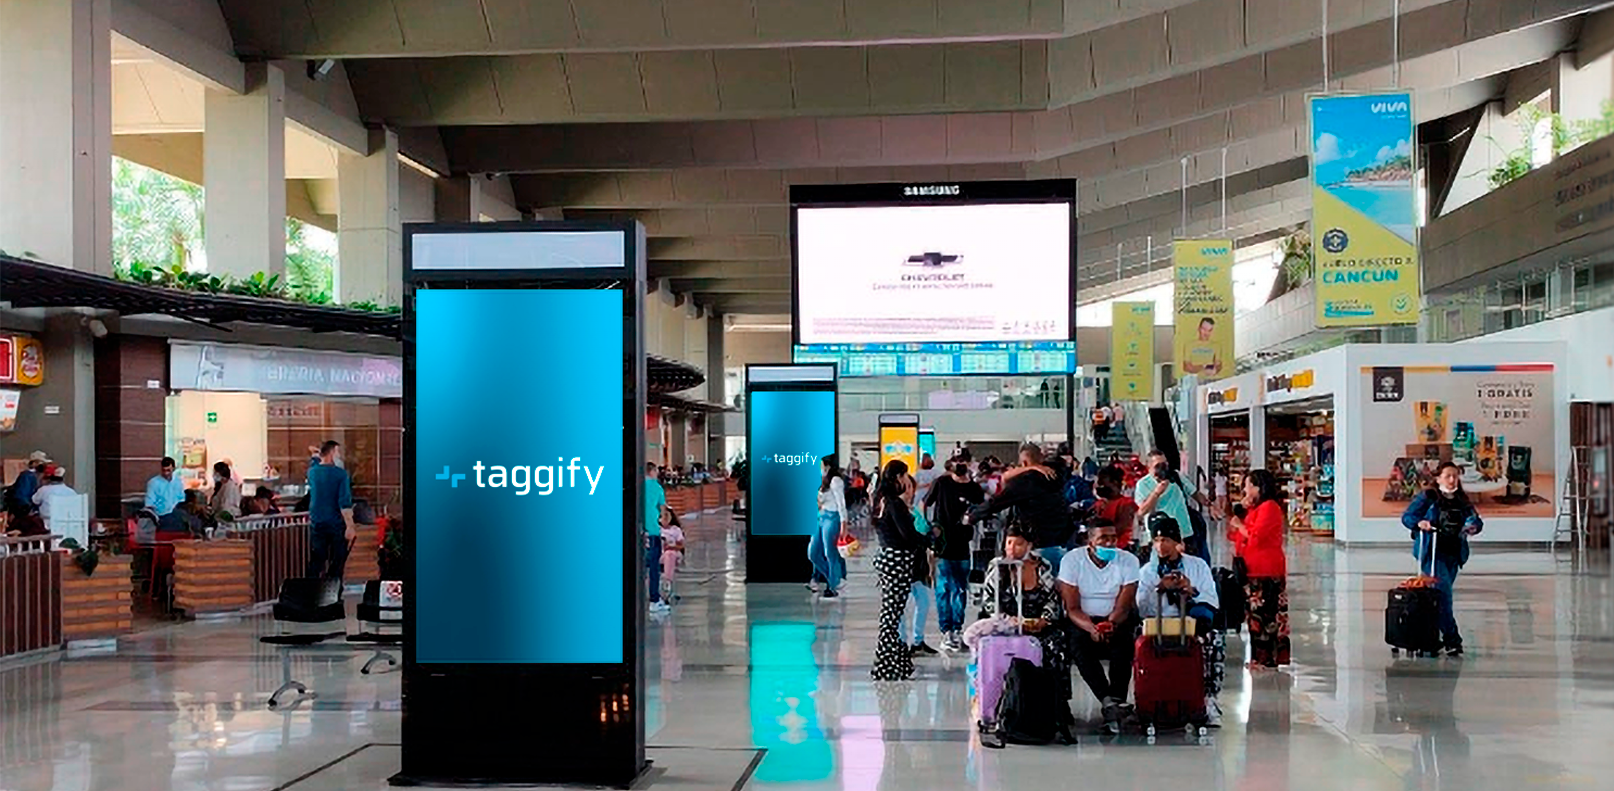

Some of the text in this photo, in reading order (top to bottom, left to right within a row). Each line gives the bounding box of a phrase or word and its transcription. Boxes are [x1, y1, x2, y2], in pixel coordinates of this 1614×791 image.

[1371, 101, 1407, 113] VIVA
[903, 185, 960, 196] SAMSUNG
[260, 365, 324, 383] IBRERIA
[773, 451, 818, 466] taggify
[472, 456, 605, 496] taggify
